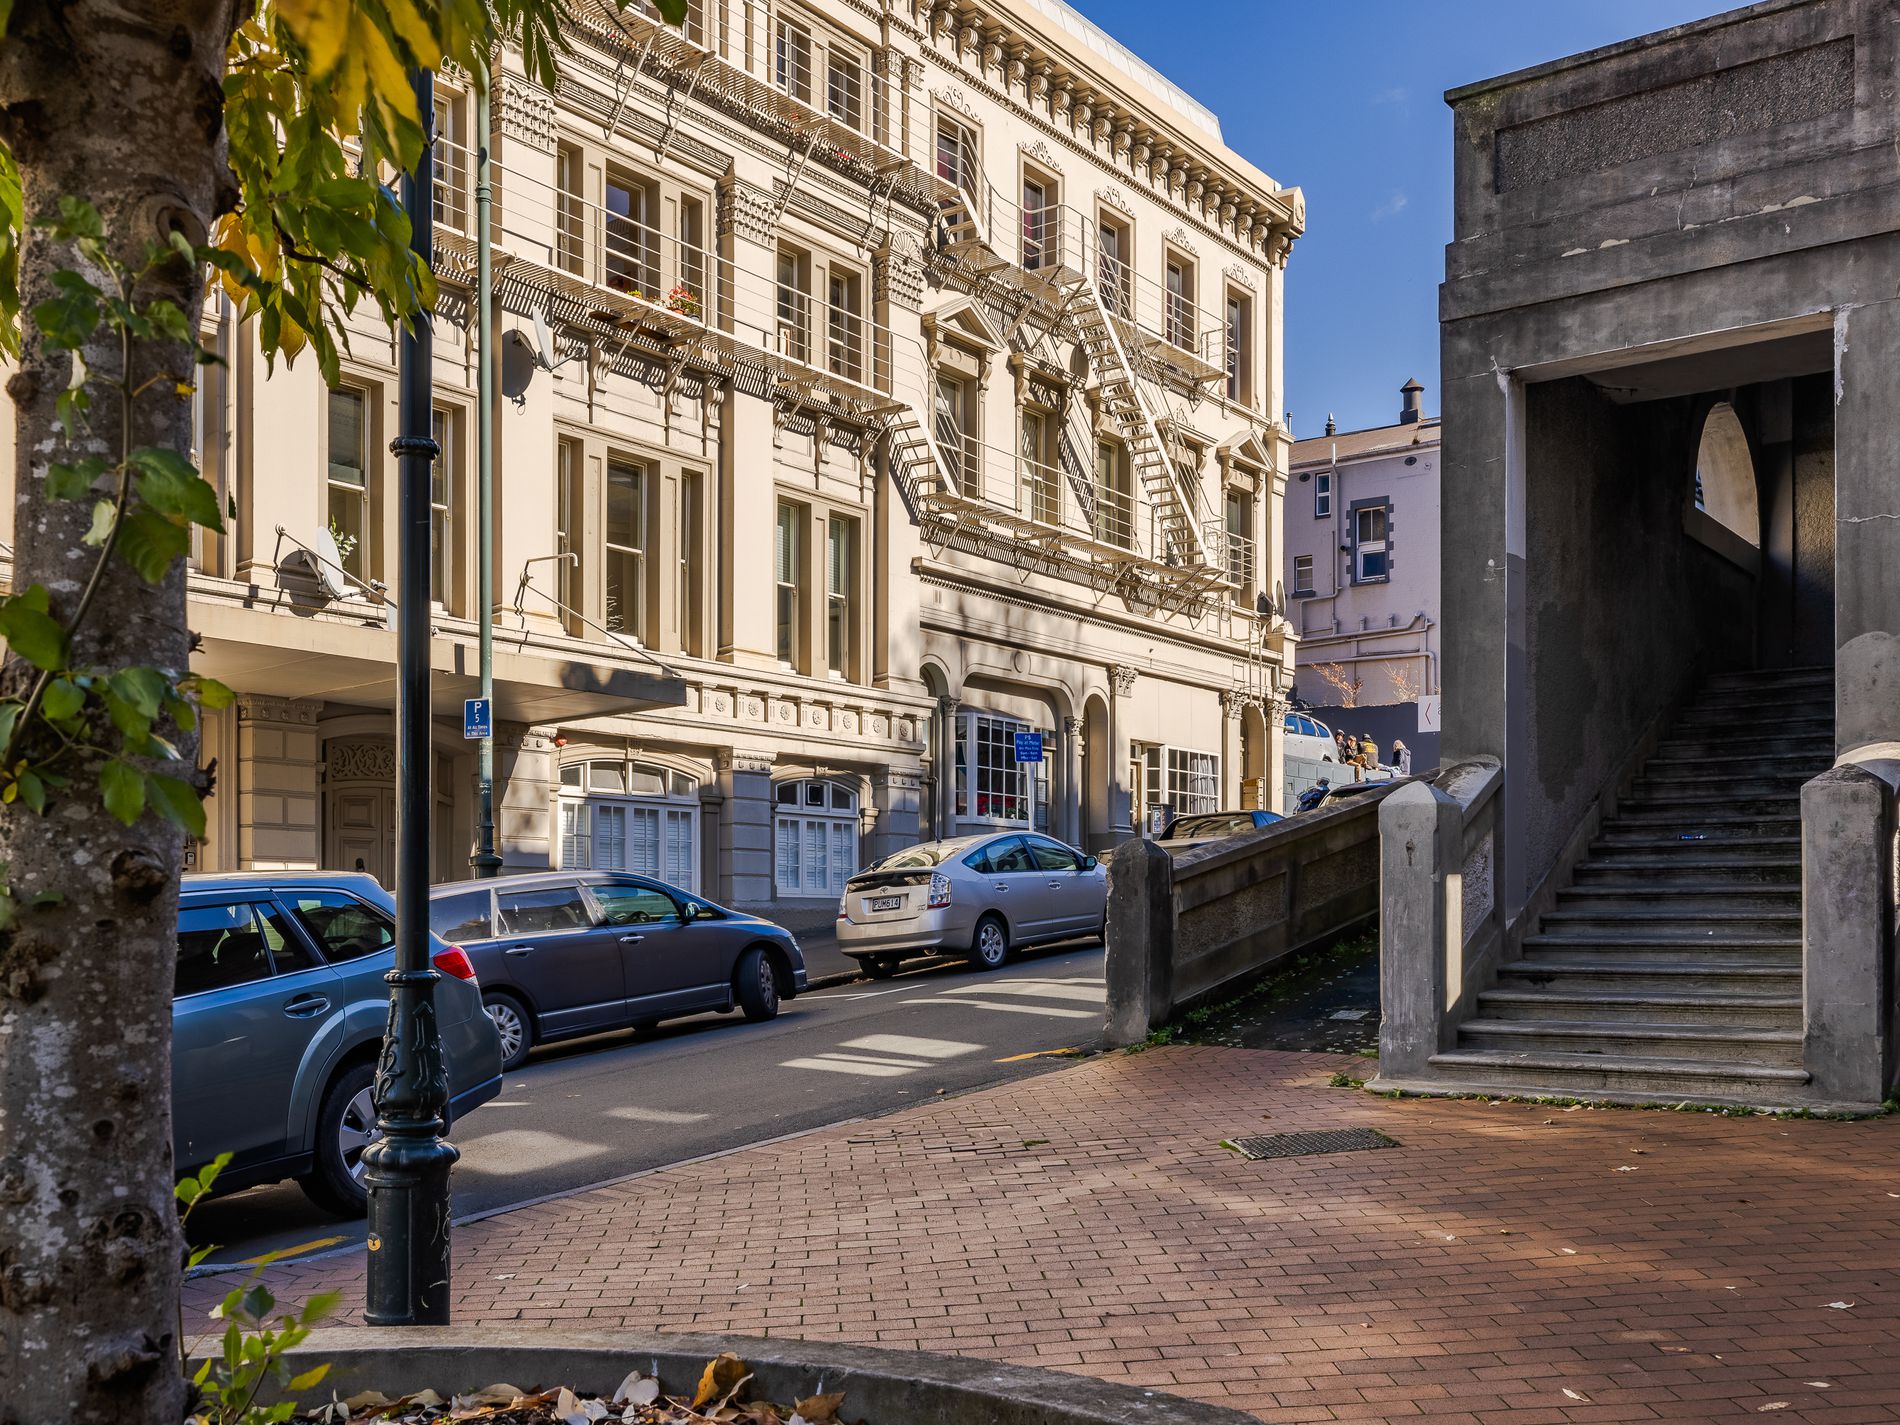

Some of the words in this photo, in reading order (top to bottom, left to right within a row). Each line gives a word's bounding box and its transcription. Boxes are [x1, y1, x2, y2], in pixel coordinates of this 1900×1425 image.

[474, 702, 482, 713] P
[475, 714, 480, 722] 5
[1155, 812, 1160, 820] P
